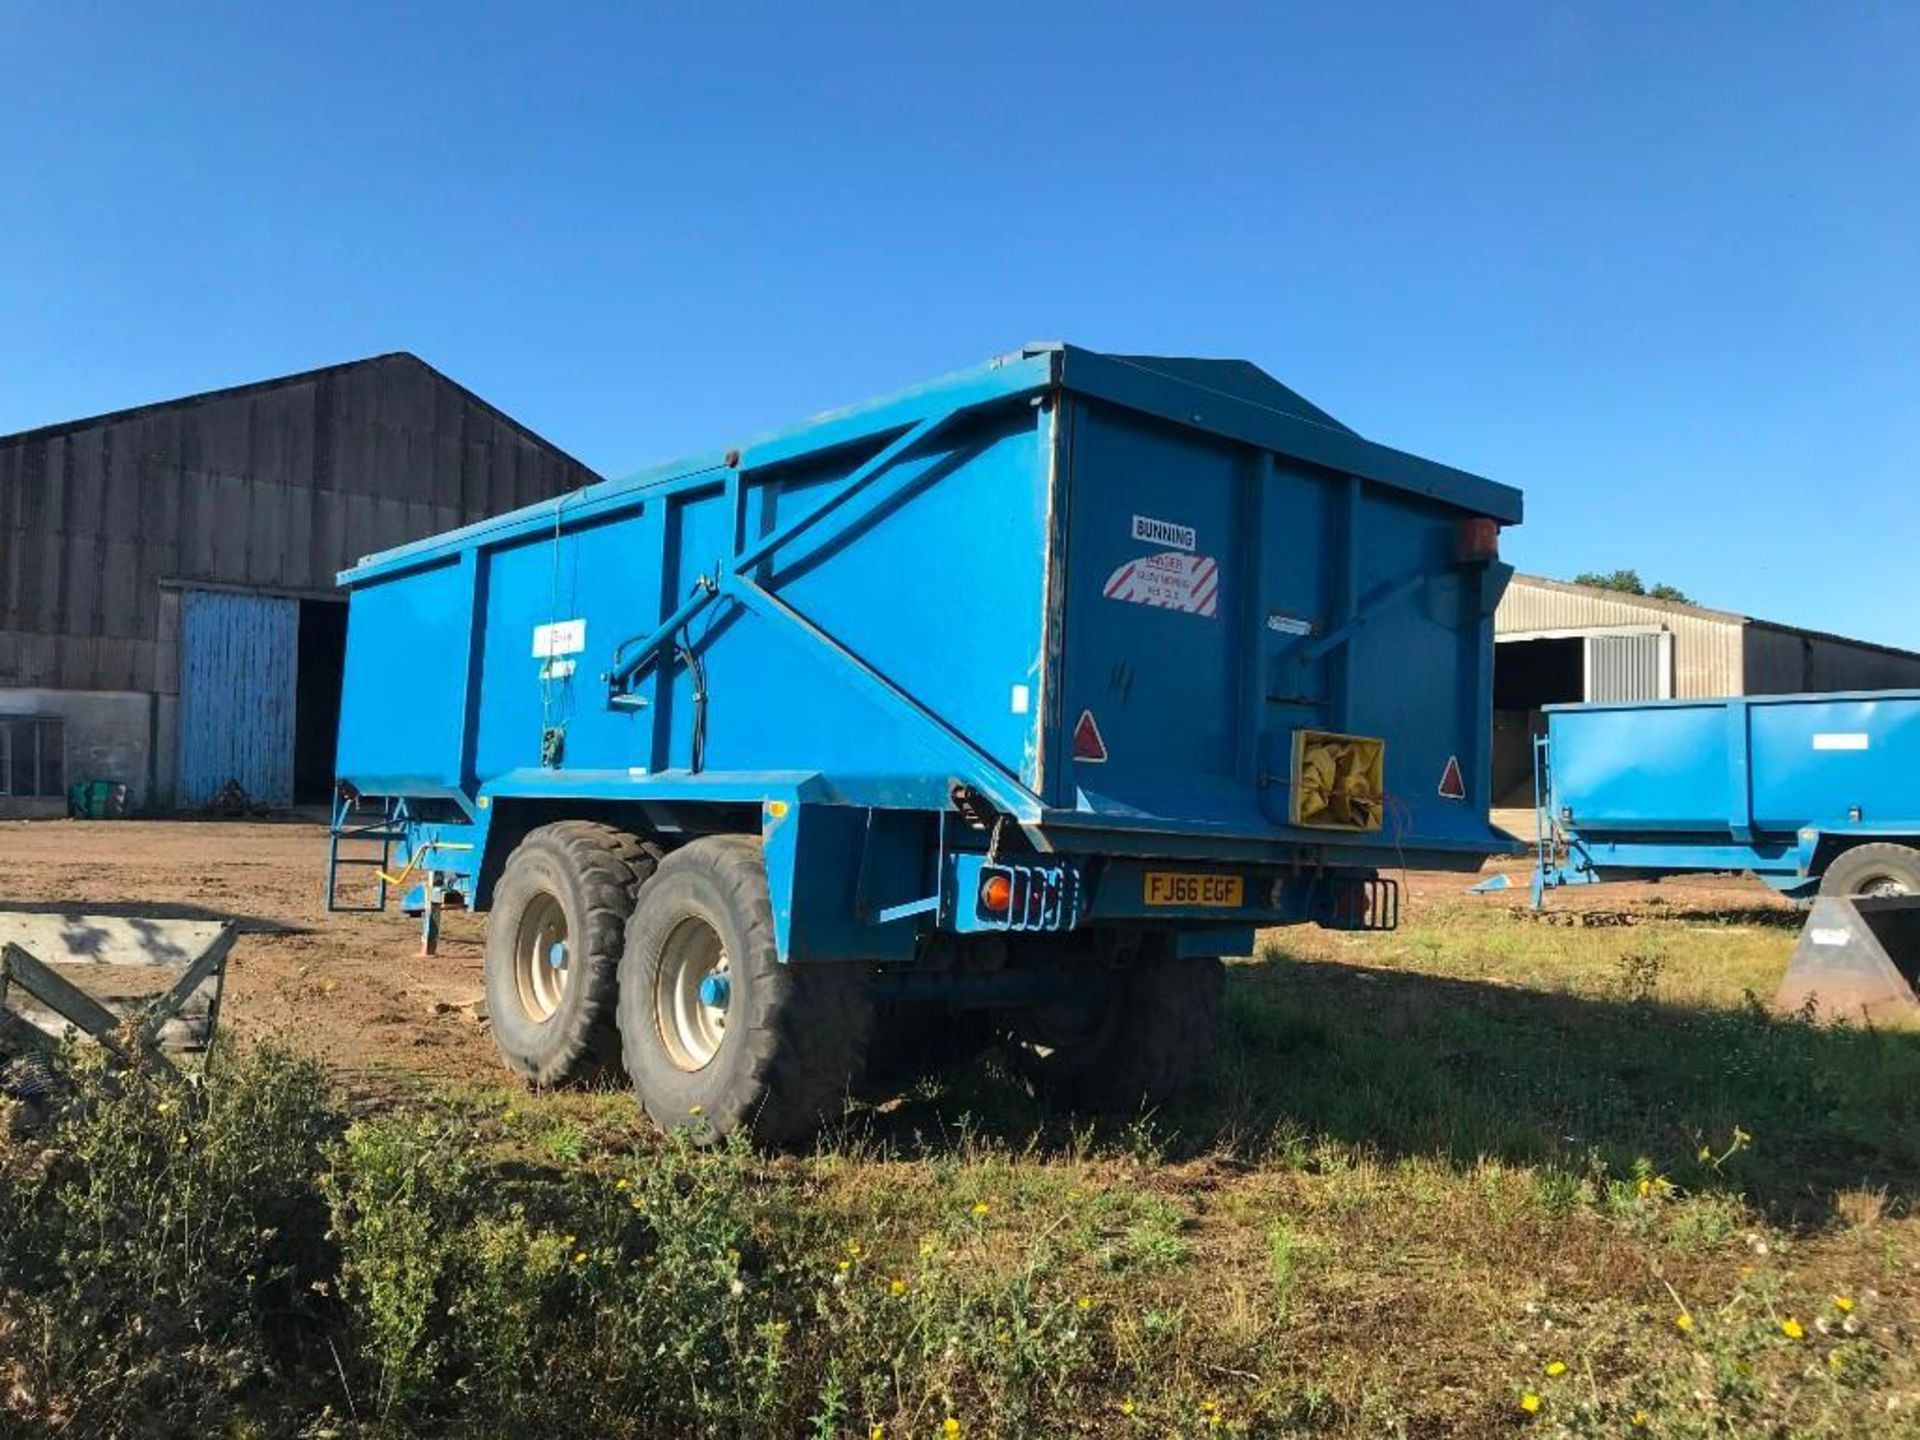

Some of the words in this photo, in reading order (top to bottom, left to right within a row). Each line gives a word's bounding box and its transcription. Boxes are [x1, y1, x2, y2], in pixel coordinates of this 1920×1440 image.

[1137, 519, 1194, 547] BUNNING
[1151, 877, 1198, 901] FJ66
[1202, 878, 1236, 902] EGF
